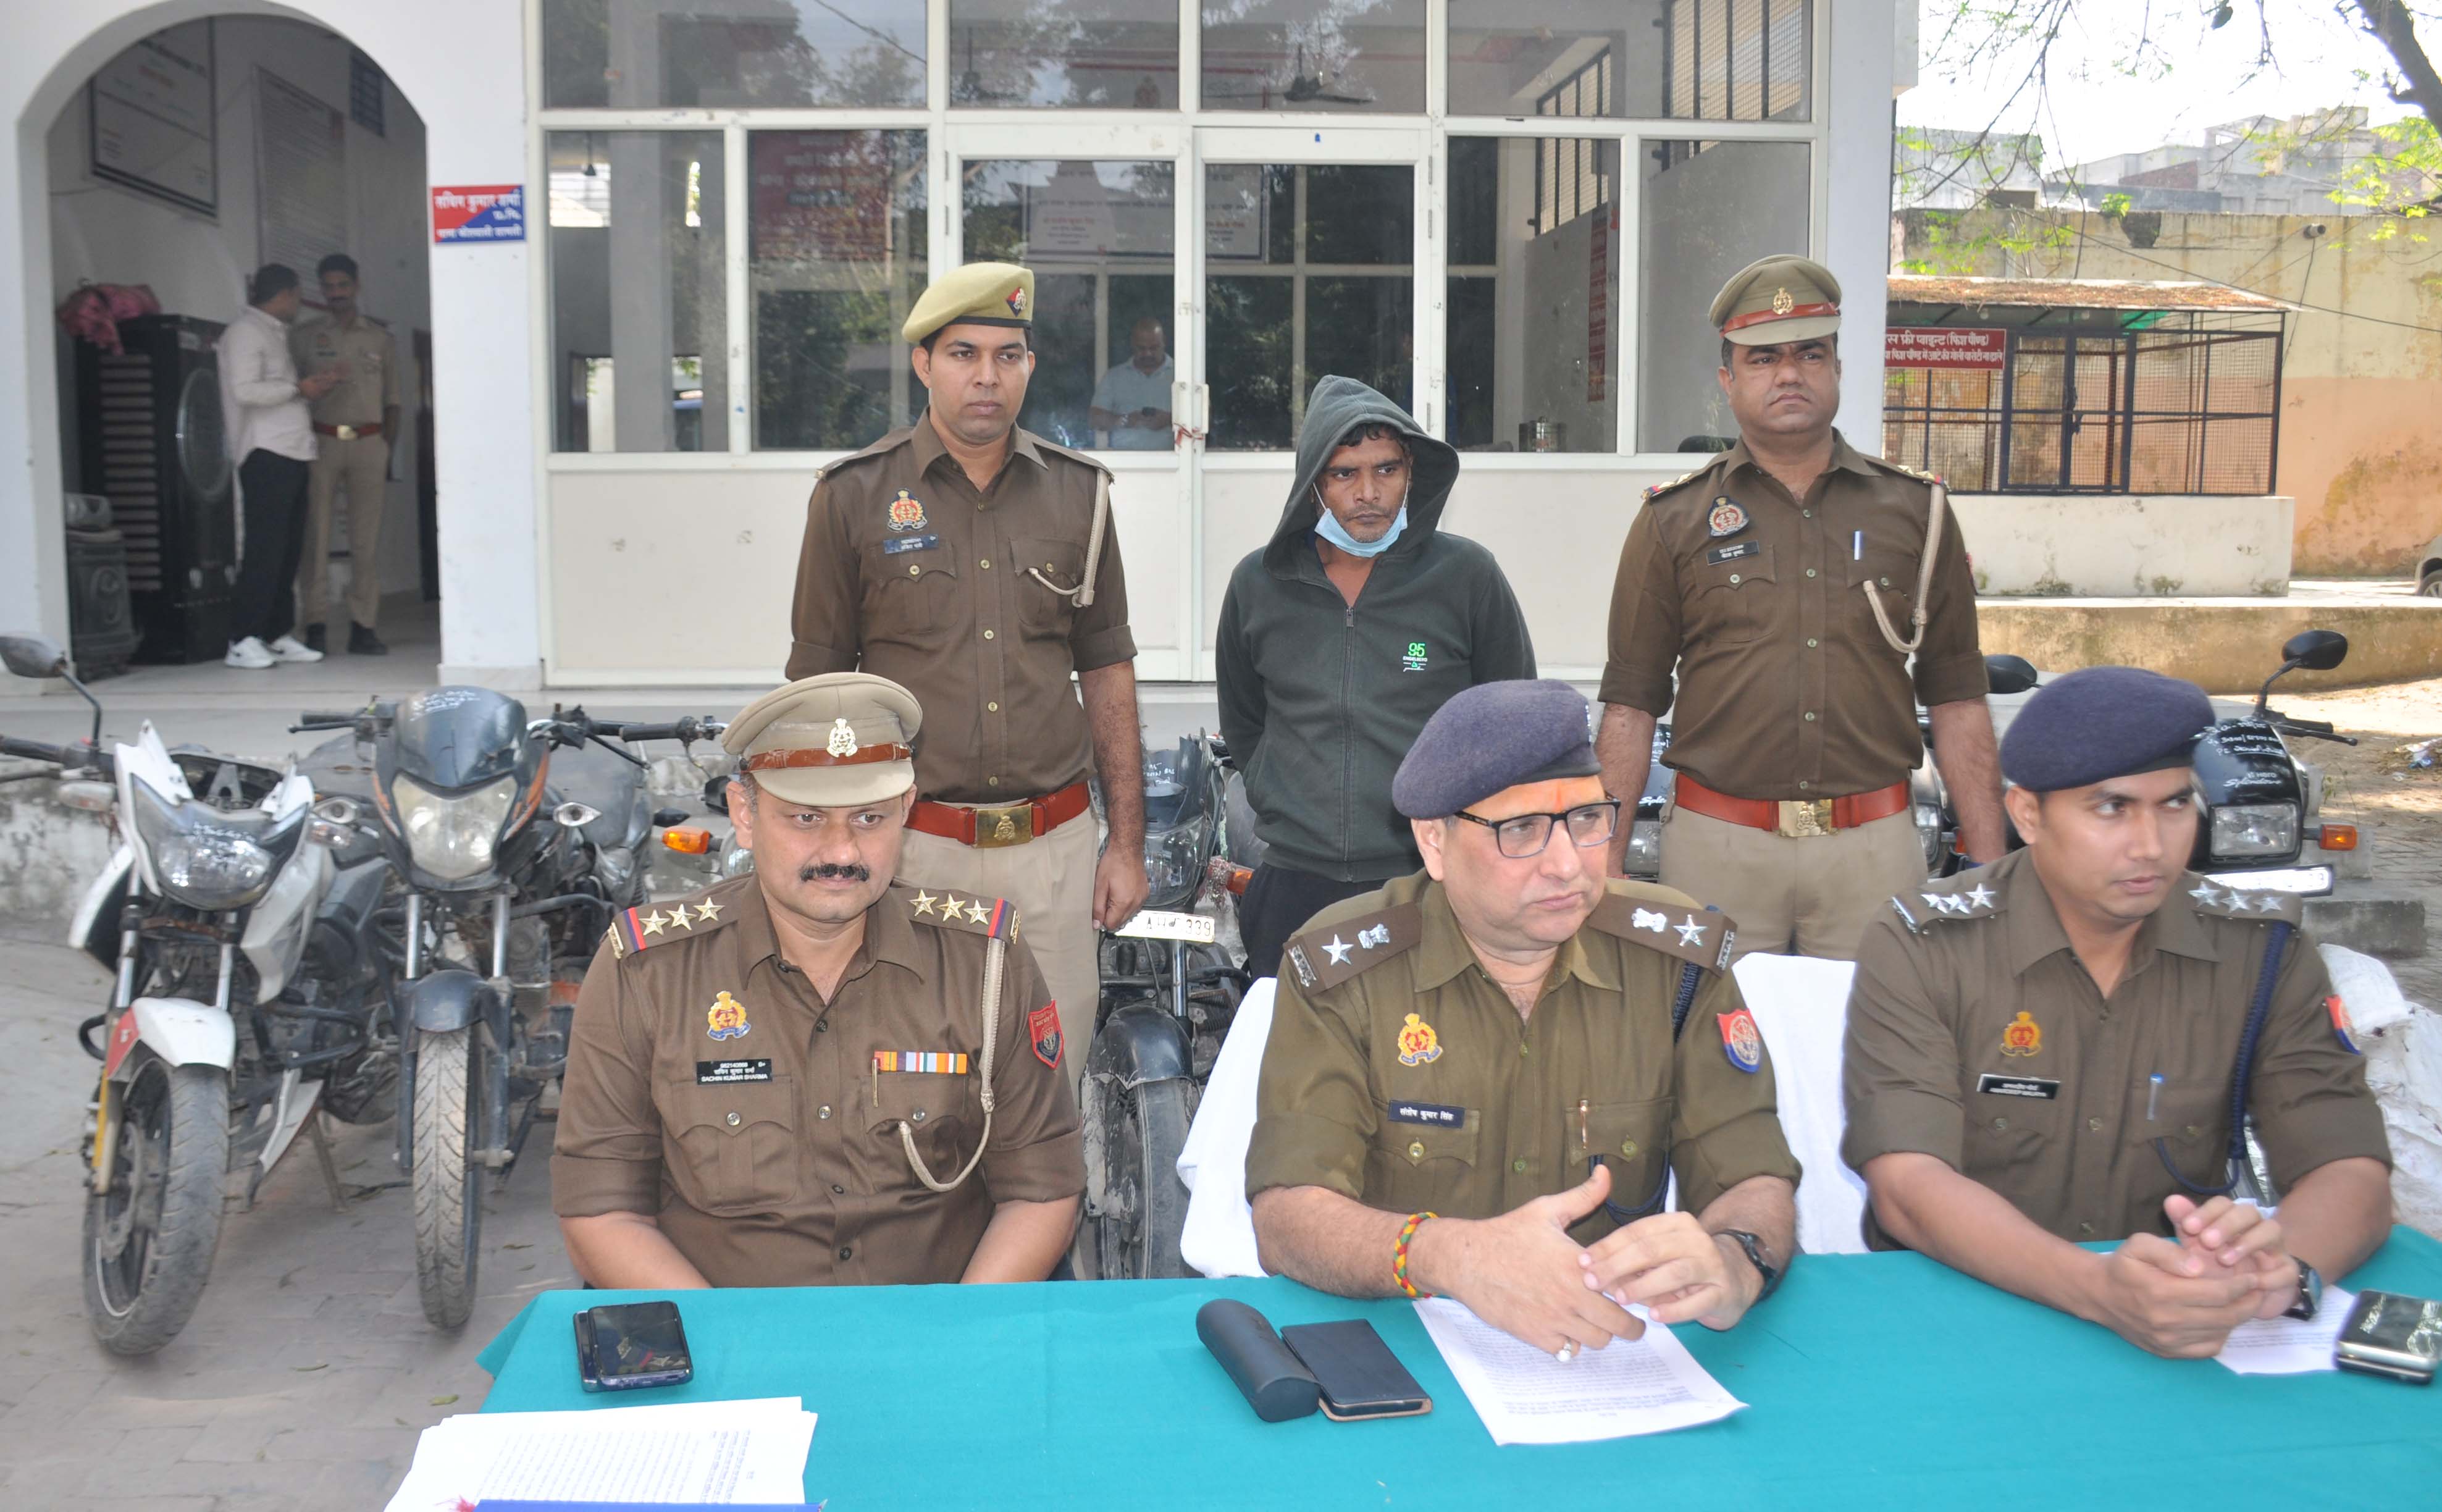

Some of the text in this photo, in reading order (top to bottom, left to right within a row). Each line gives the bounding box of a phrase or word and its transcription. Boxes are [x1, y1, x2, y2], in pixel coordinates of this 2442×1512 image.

[467, 193, 497, 213] कुमार
[1900, 329, 1915, 345] फ्री
[1408, 642, 1425, 657] 95
[1399, 1107, 1454, 1121] संतोष कुमार सिंह
